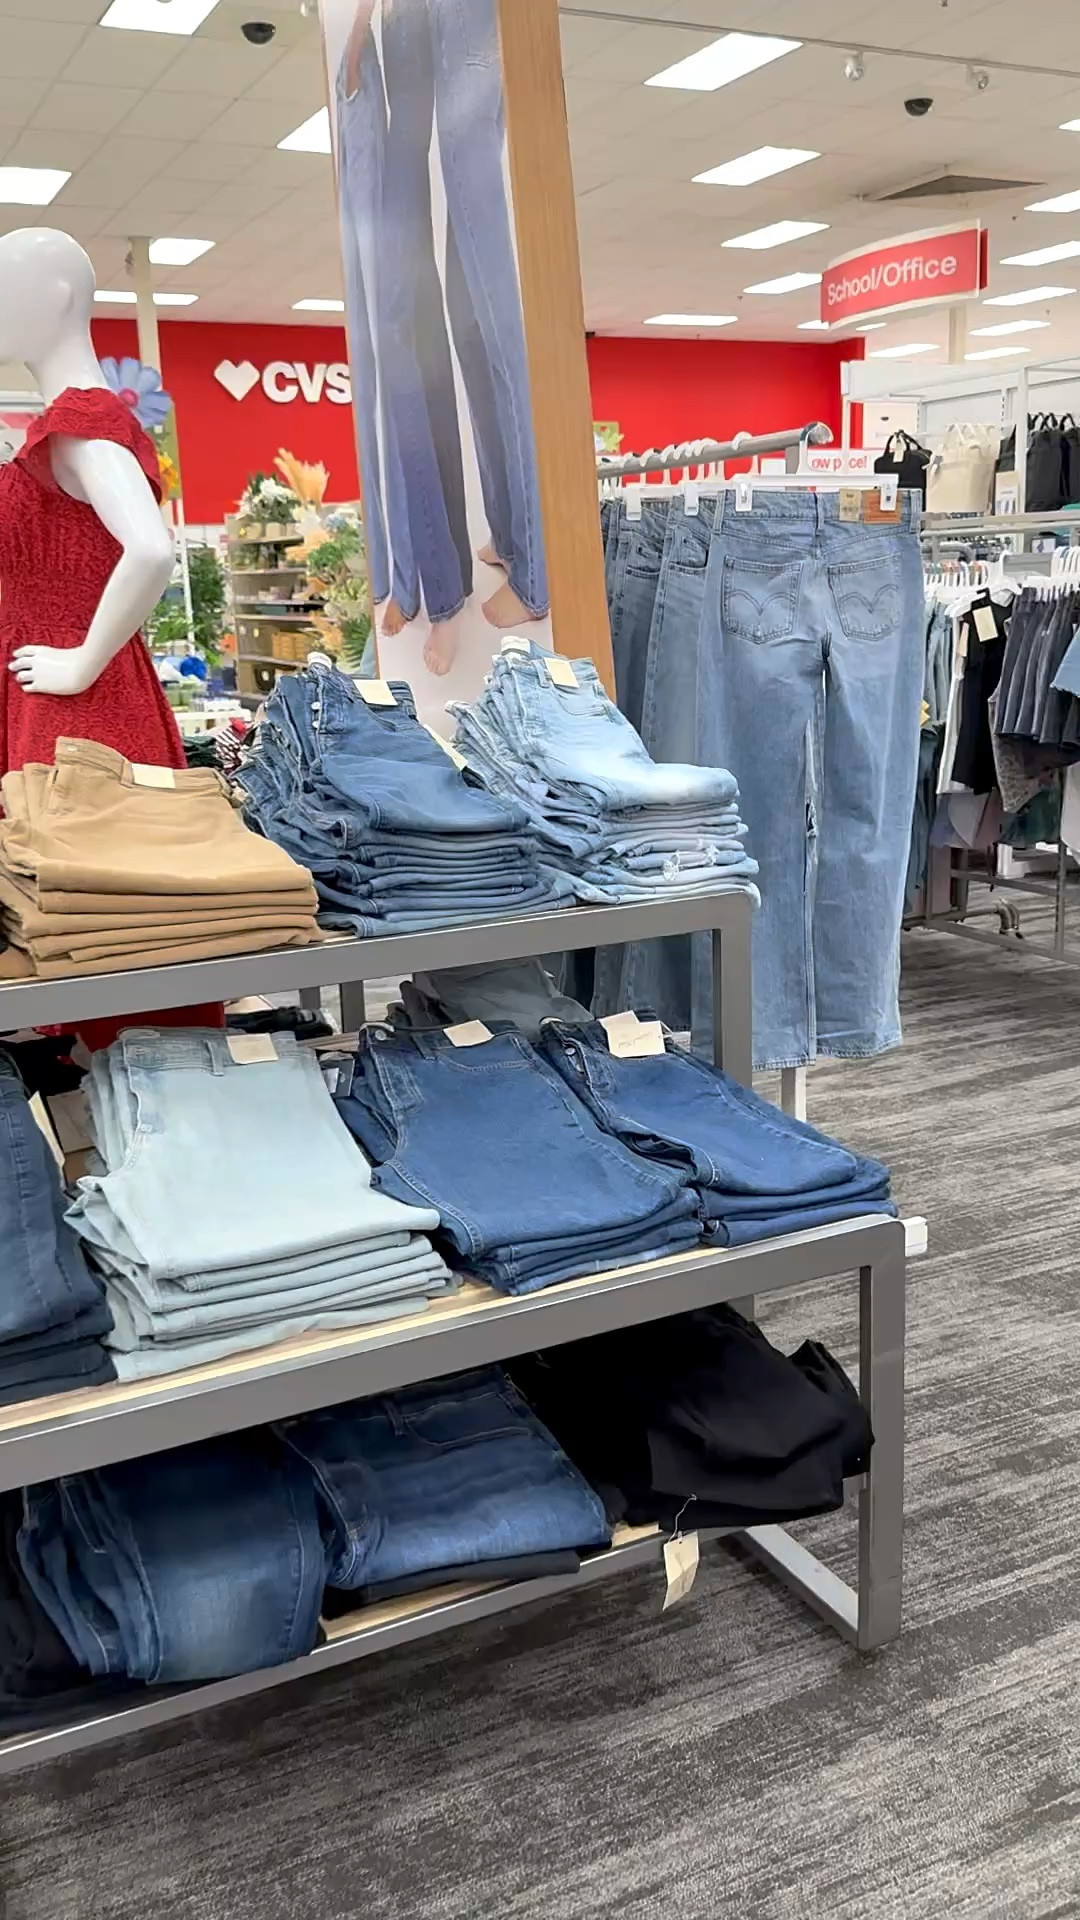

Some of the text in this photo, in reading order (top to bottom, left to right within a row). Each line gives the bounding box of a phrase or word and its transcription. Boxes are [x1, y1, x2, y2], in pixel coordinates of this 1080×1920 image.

[827, 256, 957, 305] School/Office
[262, 361, 352, 404] CVS
[810, 456, 868, 471] ow pce!
